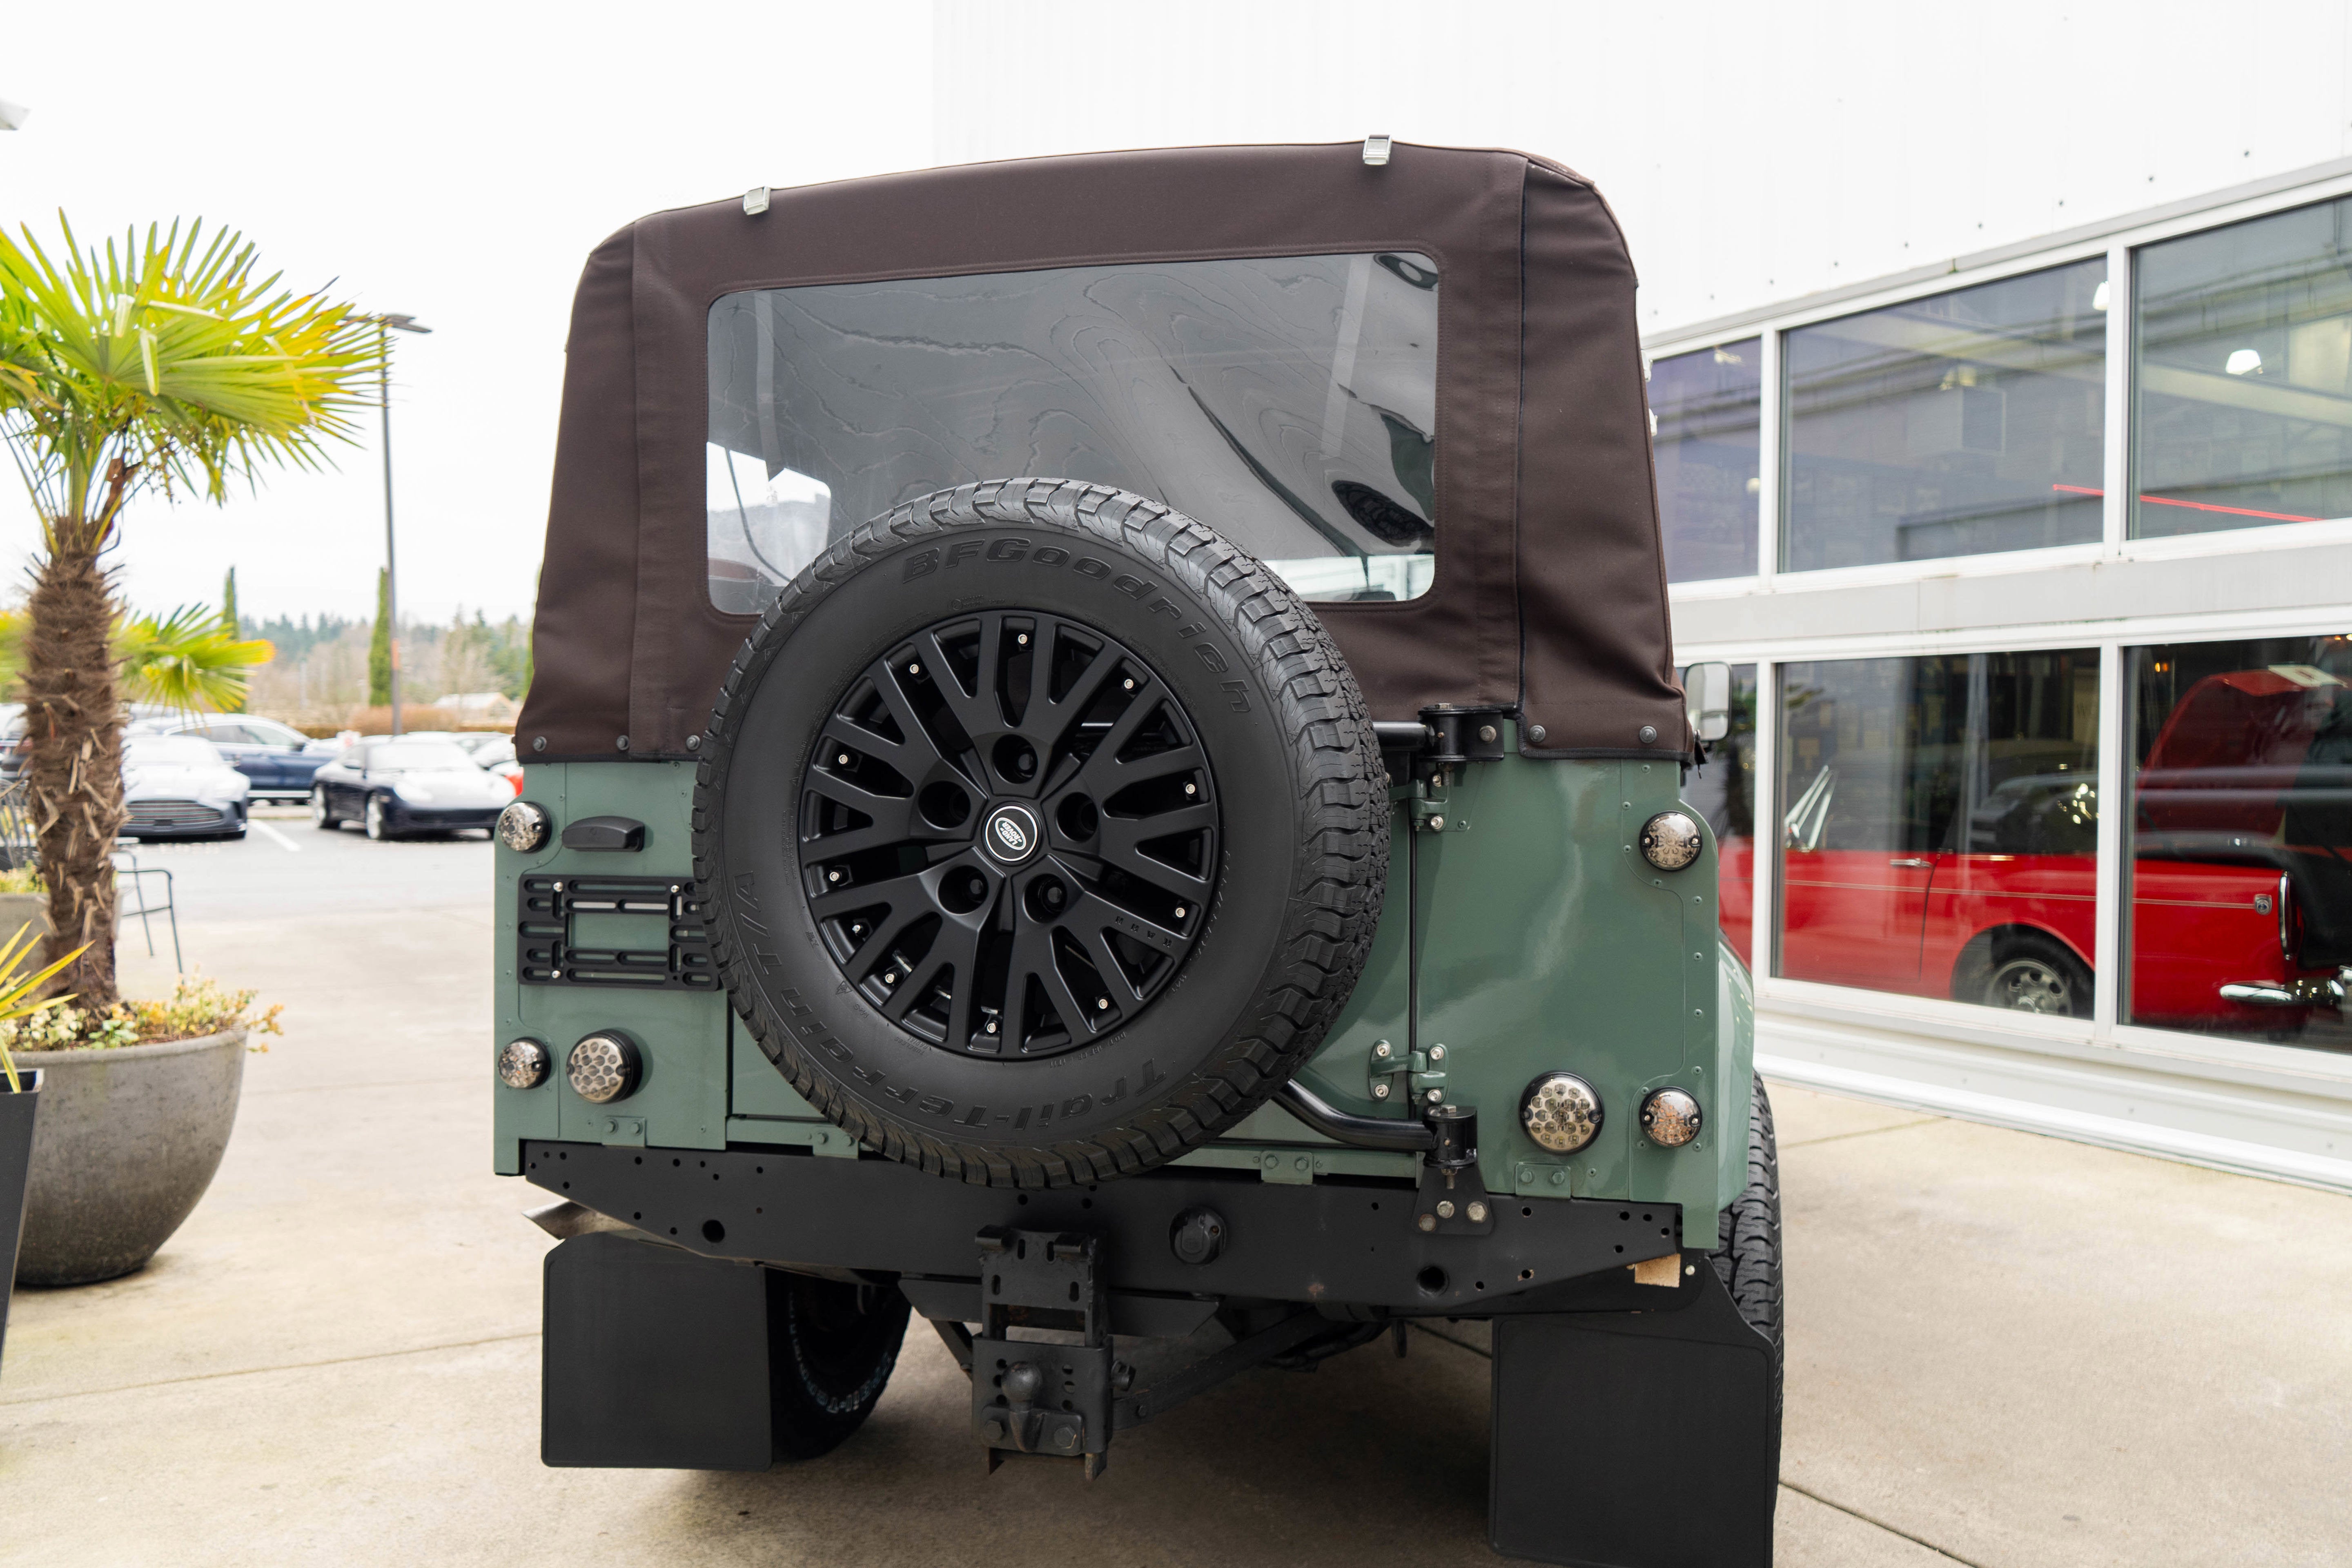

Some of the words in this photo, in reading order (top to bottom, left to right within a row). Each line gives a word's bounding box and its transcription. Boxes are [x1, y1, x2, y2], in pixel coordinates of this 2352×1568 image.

[902, 537, 1251, 713] BFGoodrich
[1001, 830, 1018, 846] LAND
[1002, 821, 1021, 840] ROVER
[735, 871, 782, 975] T/A
[1115, 916, 1172, 948] KAHN
[780, 987, 1167, 1130] Trail-Terrain
